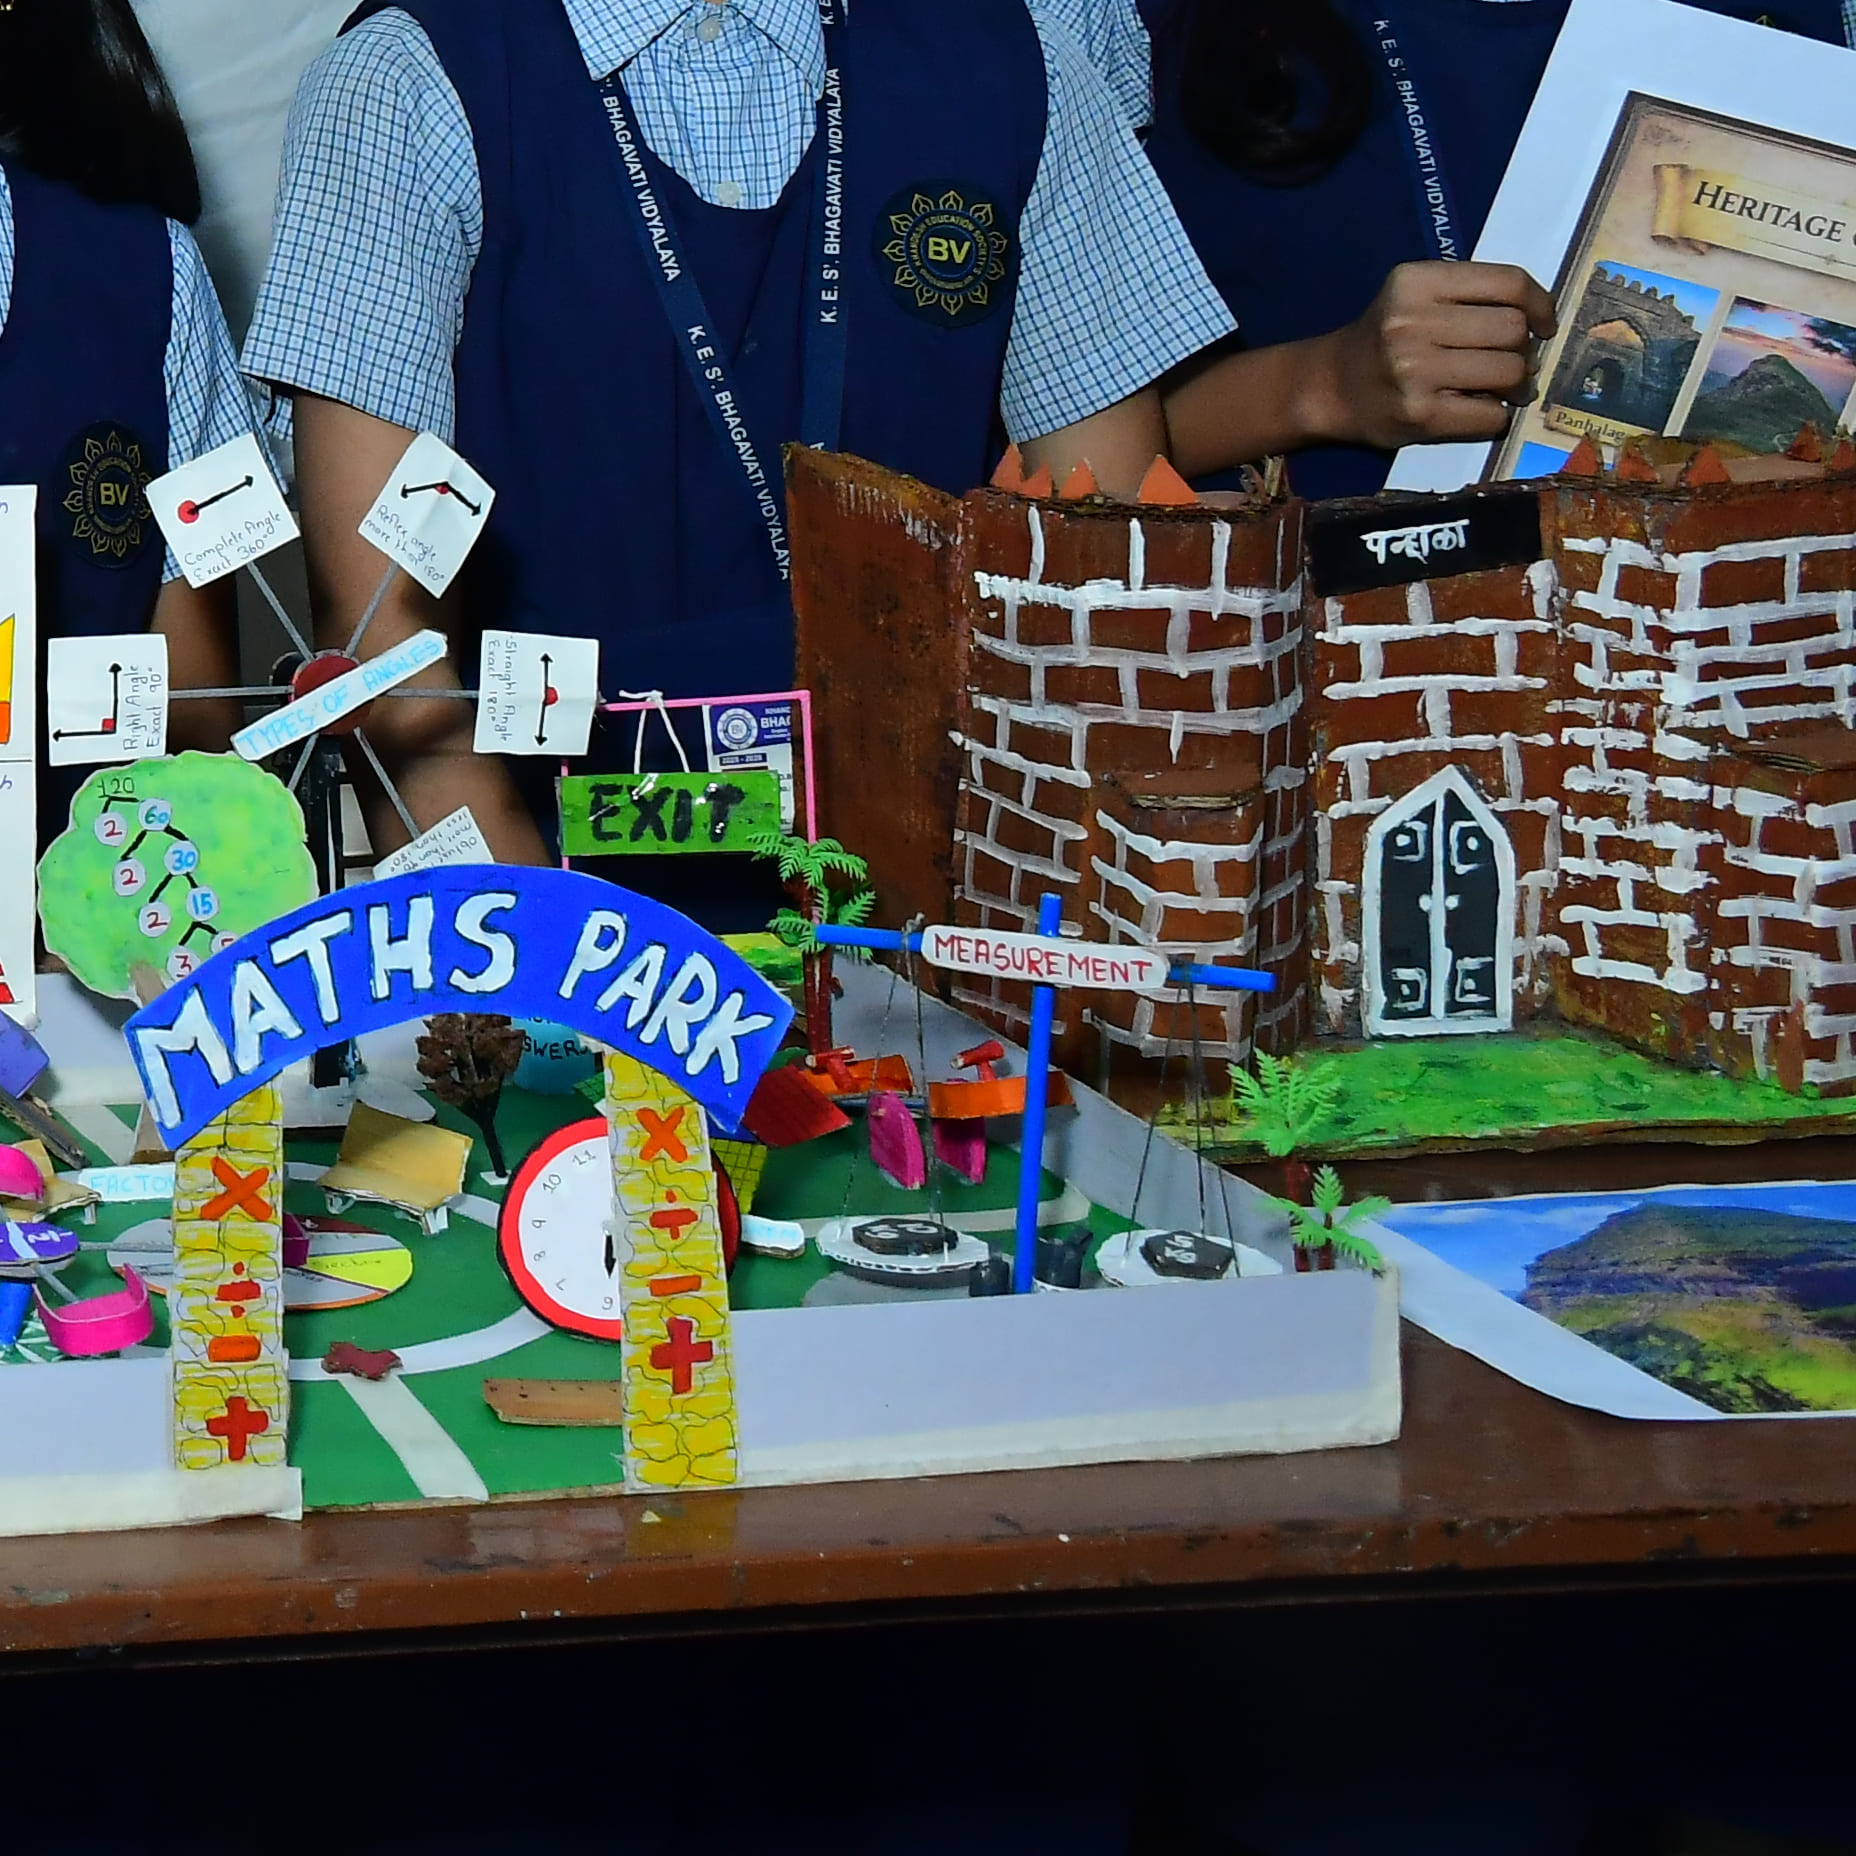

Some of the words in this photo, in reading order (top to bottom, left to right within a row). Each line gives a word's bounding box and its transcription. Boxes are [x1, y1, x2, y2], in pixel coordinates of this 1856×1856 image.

[1692, 180, 1847, 243] HERITAGE
[1360, 519, 1470, 565] पन्हाळा
[589, 782, 746, 844] EXIT
[933, 933, 1153, 984] MEASUREMENT
[132, 892, 520, 1130] MATHS
[558, 908, 776, 1085] PARK
